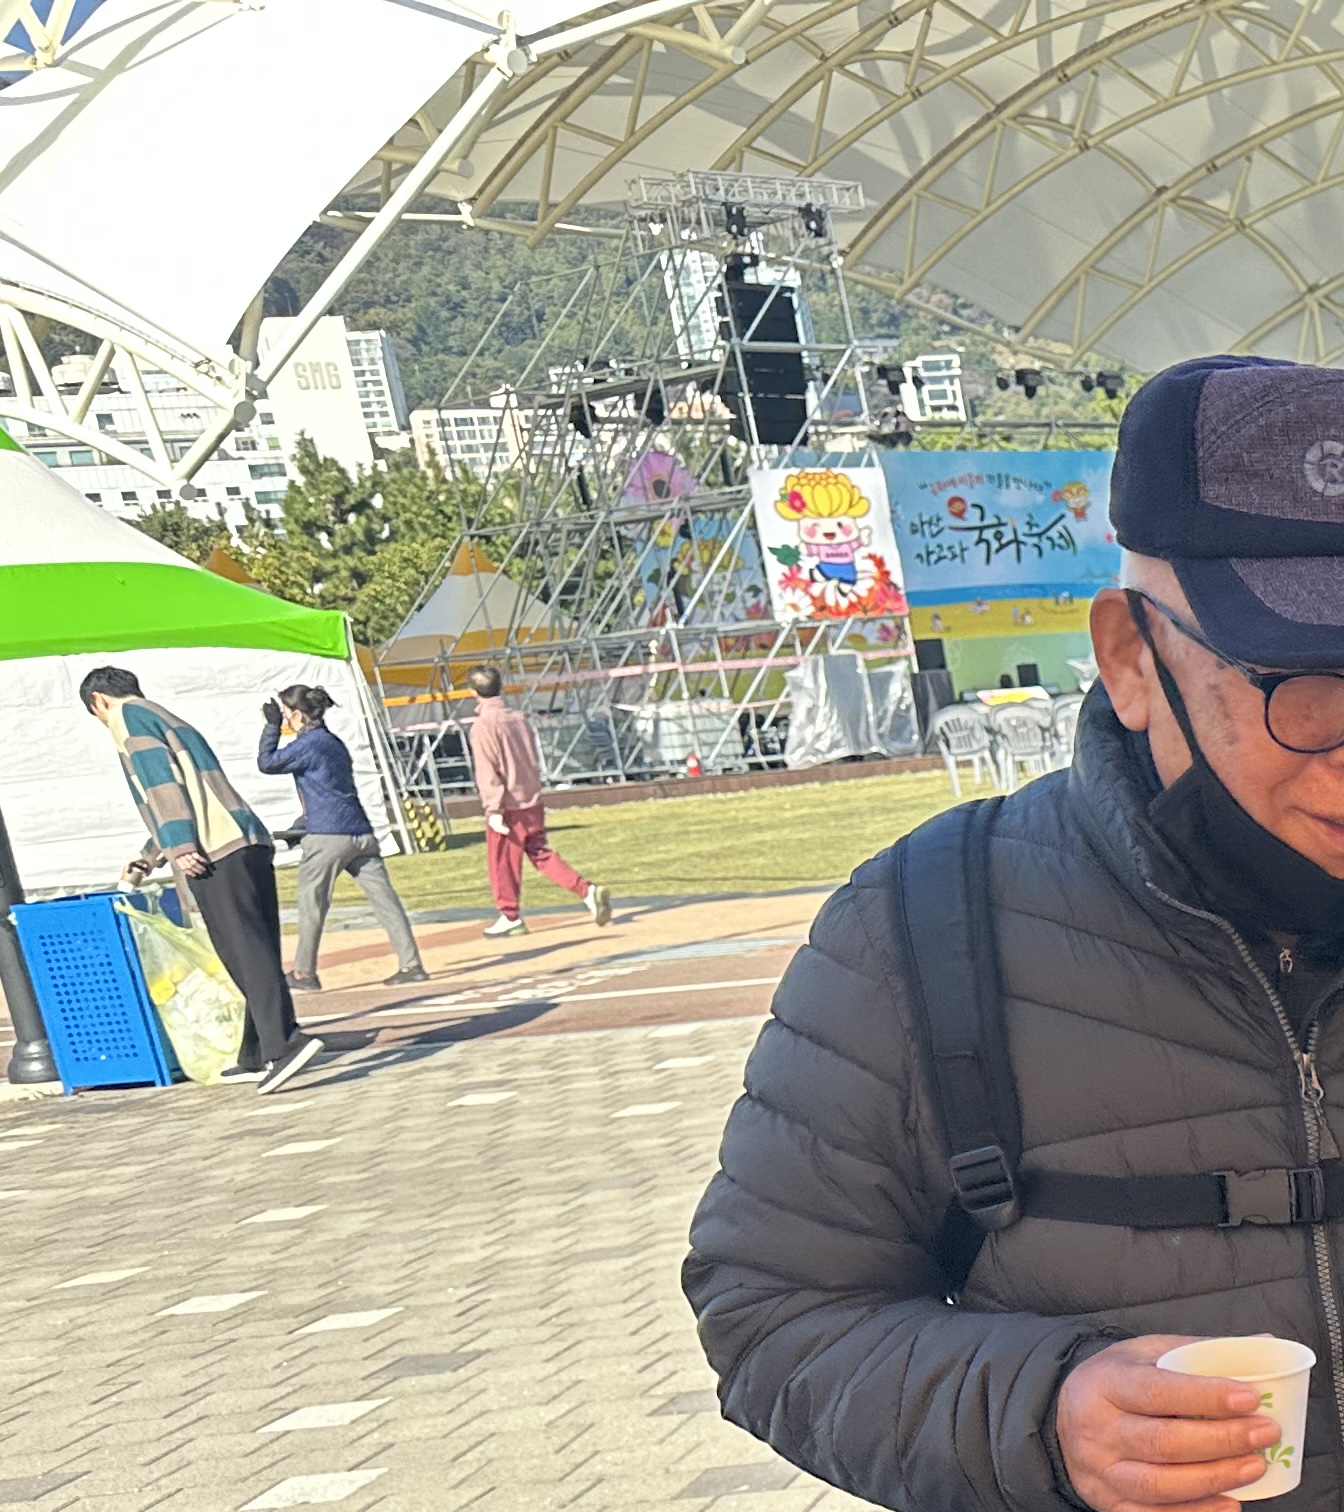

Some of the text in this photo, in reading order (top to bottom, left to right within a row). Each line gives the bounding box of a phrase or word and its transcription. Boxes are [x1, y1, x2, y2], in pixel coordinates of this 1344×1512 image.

[293, 361, 342, 390] SMG
[909, 512, 946, 538] 마산
[948, 503, 1077, 565] 국화축제
[914, 538, 969, 566] 가고파
